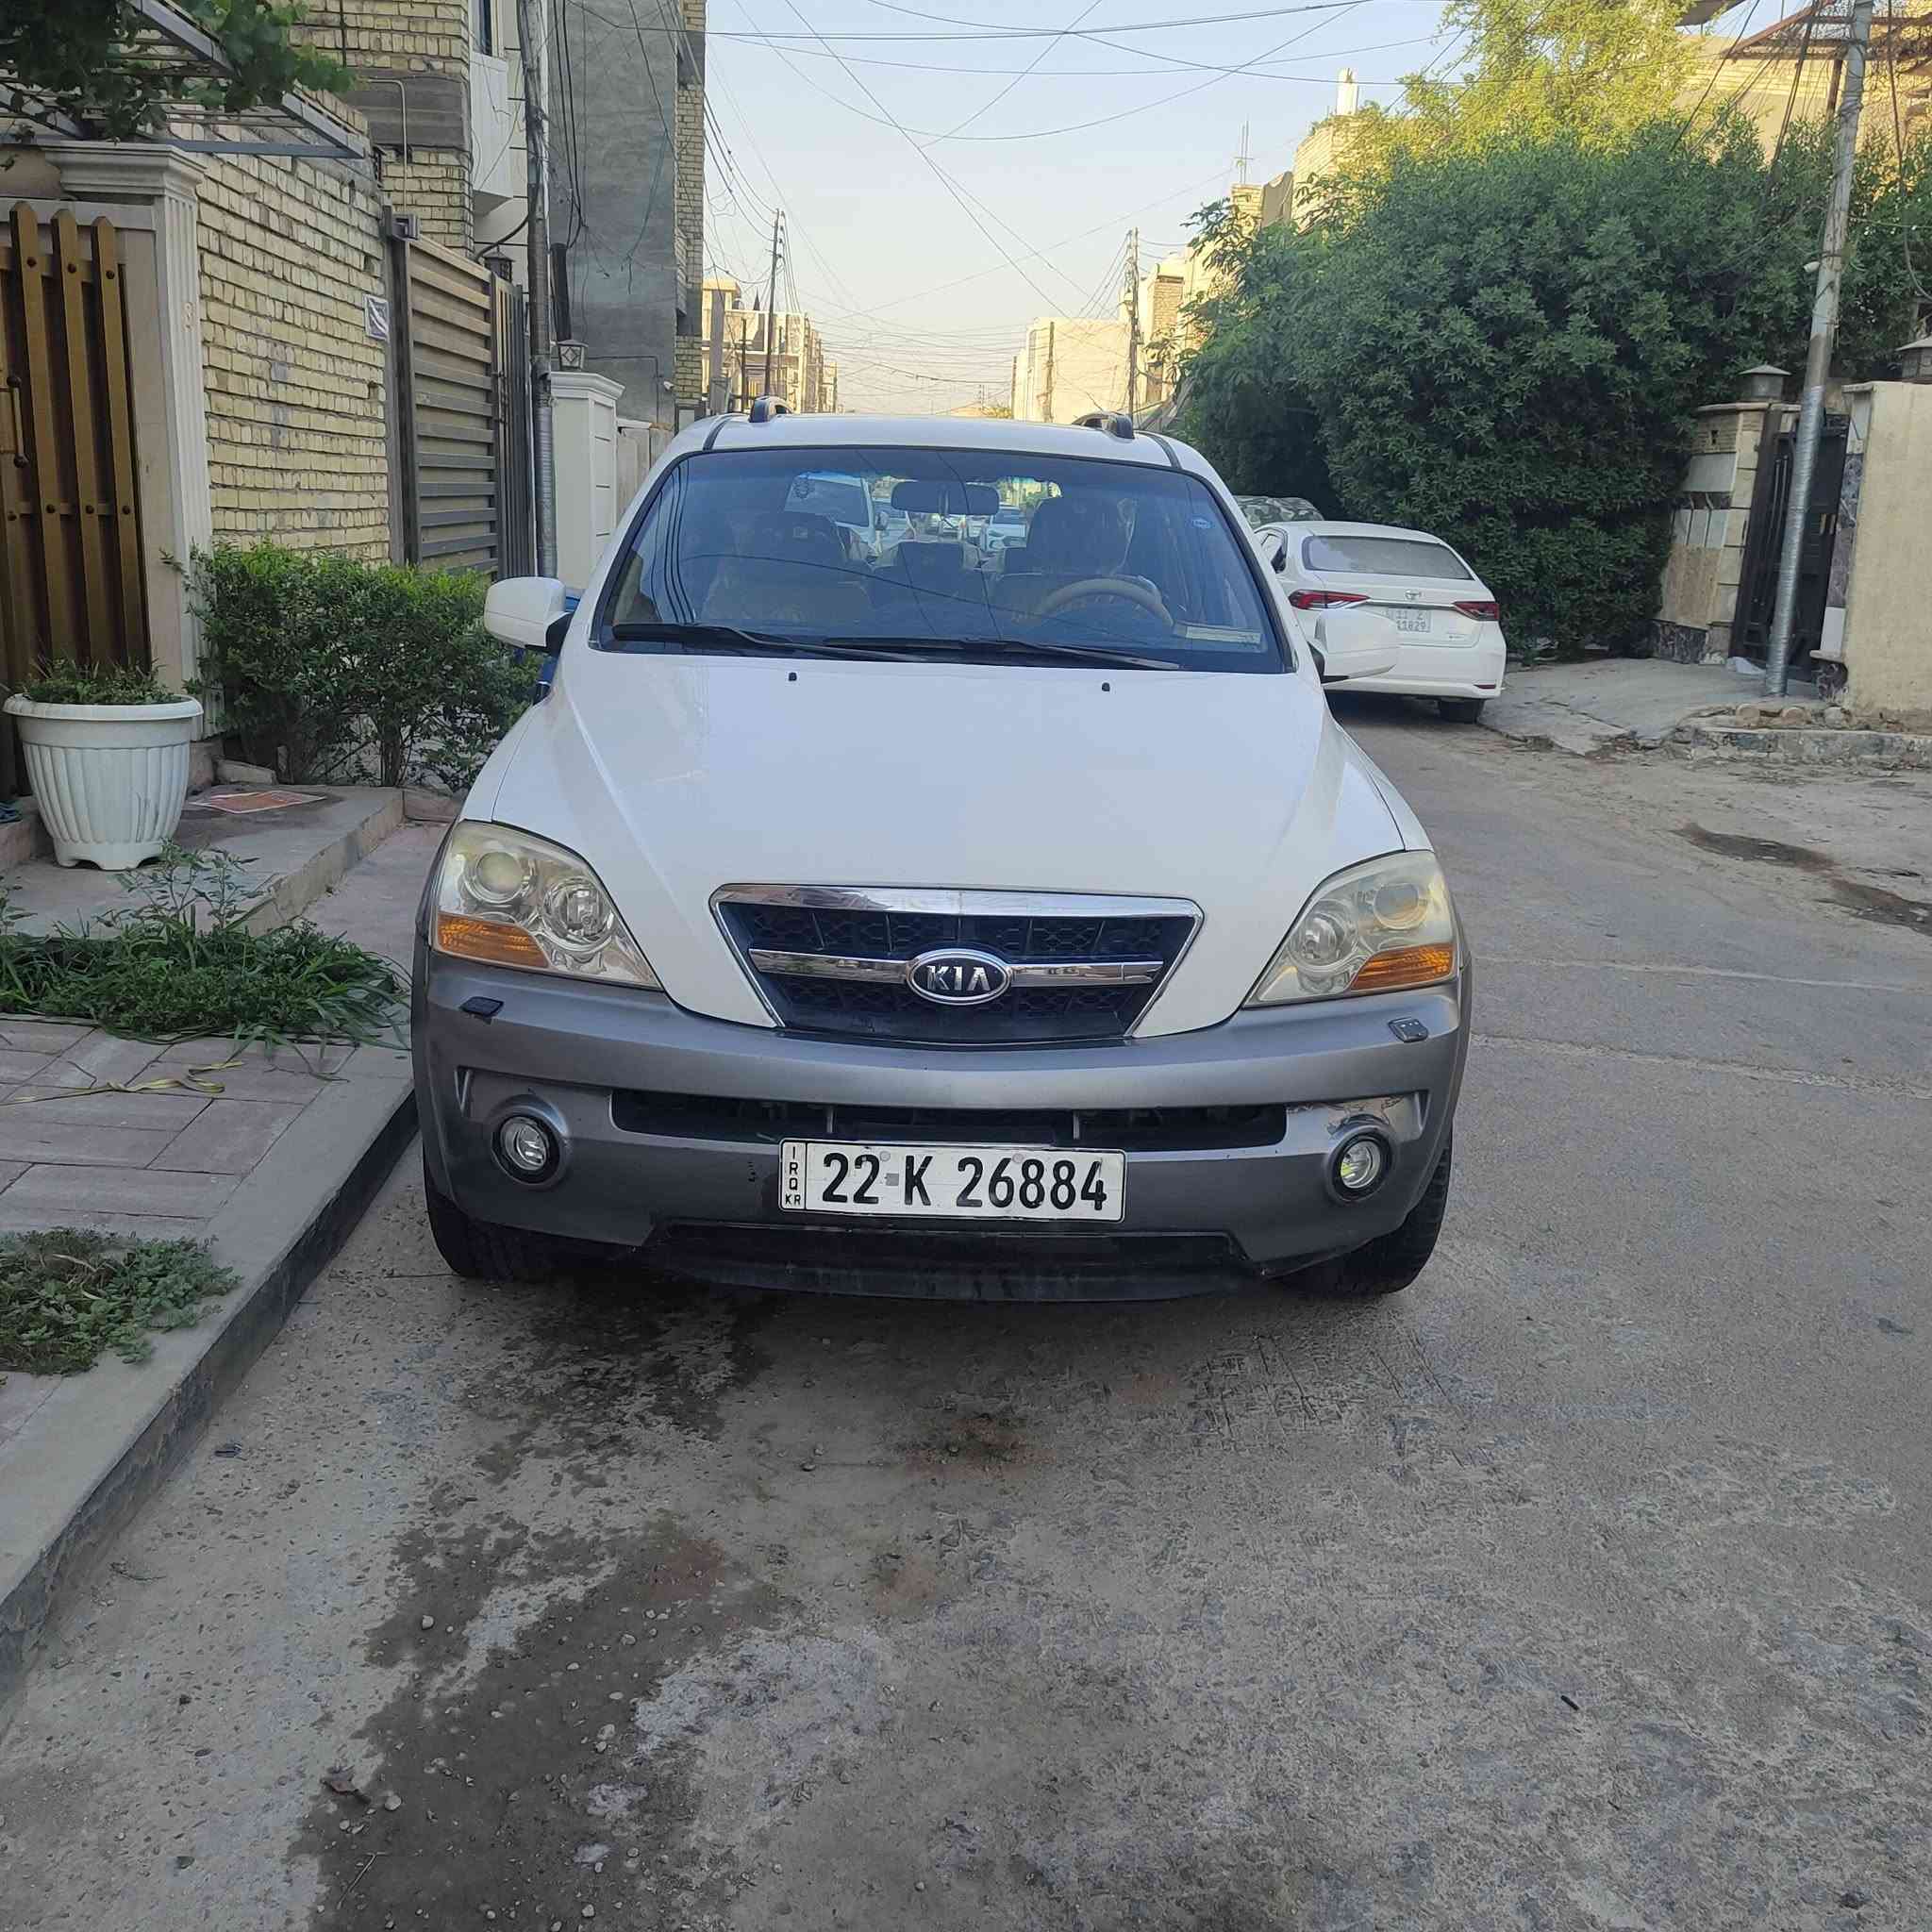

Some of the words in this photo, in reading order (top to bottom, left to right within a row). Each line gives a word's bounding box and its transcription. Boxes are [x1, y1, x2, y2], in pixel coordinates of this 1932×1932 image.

[925, 965, 991, 991] KIA
[822, 1153, 880, 1205] 22
[904, 1155, 934, 1207] K
[956, 1157, 1108, 1211] 26884
[785, 1193, 802, 1206] KR
